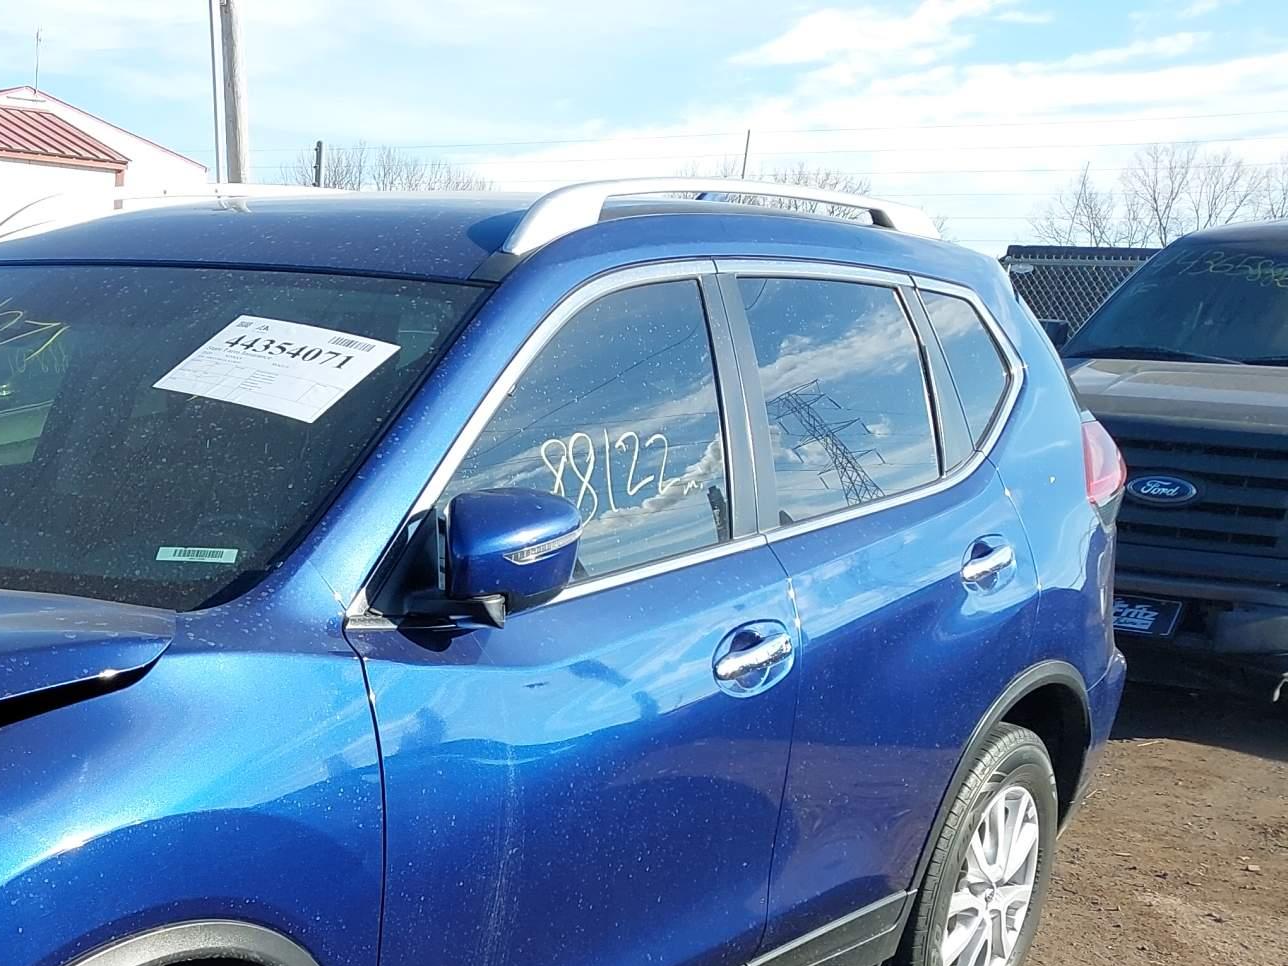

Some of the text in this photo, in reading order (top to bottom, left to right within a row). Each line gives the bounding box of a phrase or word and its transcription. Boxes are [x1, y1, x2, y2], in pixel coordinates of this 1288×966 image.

[224, 334, 355, 370] 44354071
[540, 428, 681, 527] 88122
[1140, 480, 1181, 497] Ford
